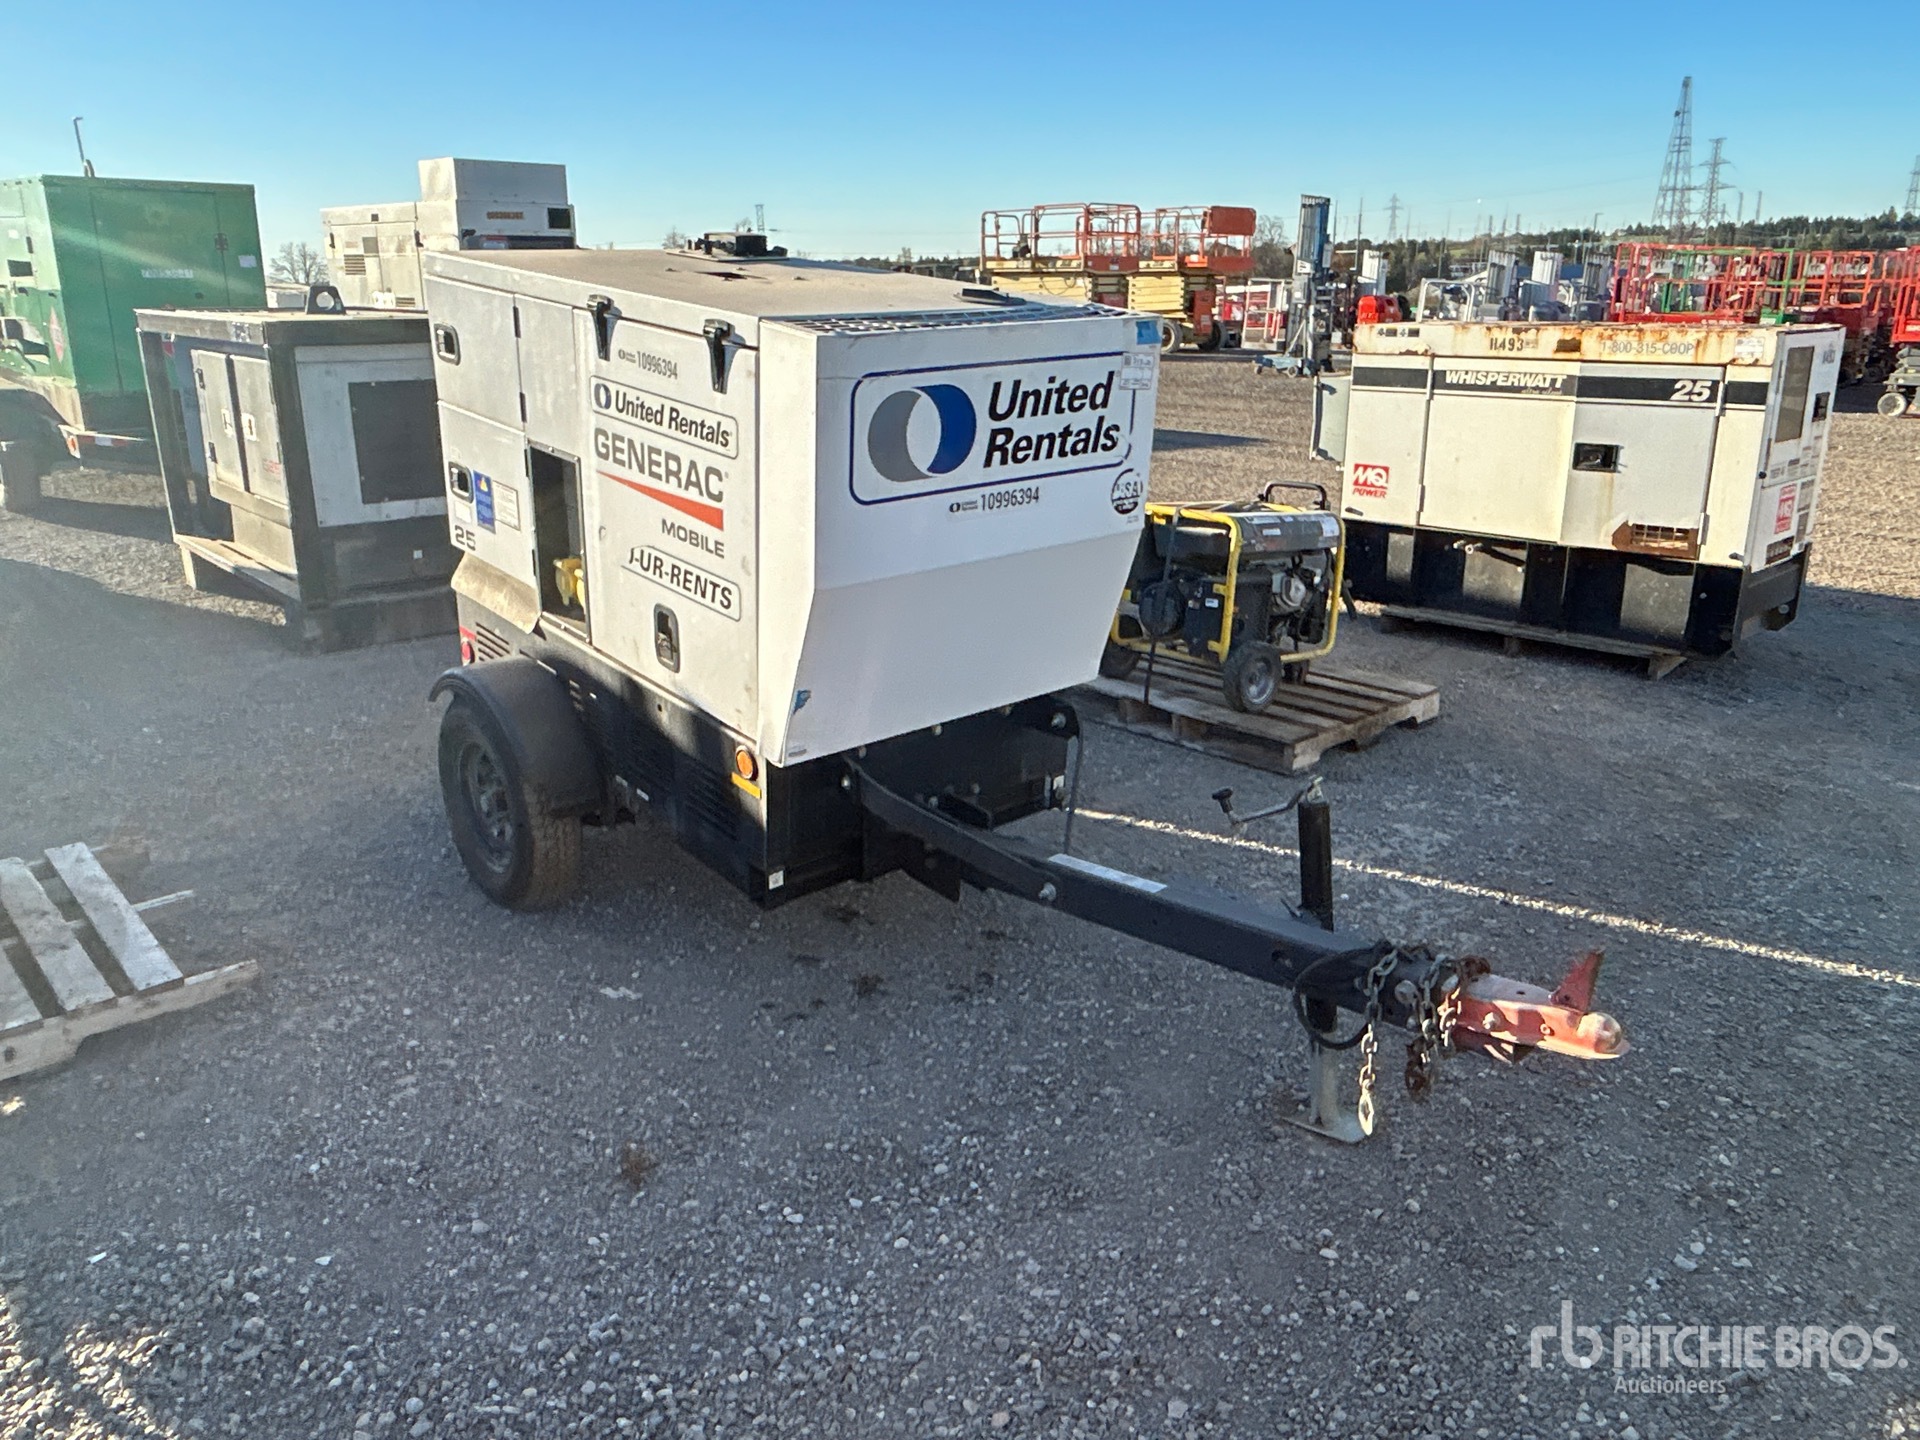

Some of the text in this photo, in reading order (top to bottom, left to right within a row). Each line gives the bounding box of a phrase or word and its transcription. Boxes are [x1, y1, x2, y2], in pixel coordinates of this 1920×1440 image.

[636, 350, 678, 379] 10996394
[988, 370, 1116, 422] United
[1445, 370, 1713, 401] WHISPERWATT 25
[615, 389, 730, 449] United Rentals
[983, 415, 1121, 468] Rentals
[593, 427, 724, 503] GENERAC
[1353, 465, 1388, 489] MQ
[980, 486, 1039, 511] 10996394
[1352, 488, 1387, 499] POWER
[454, 524, 477, 551] 25
[662, 517, 725, 559] MOBILE
